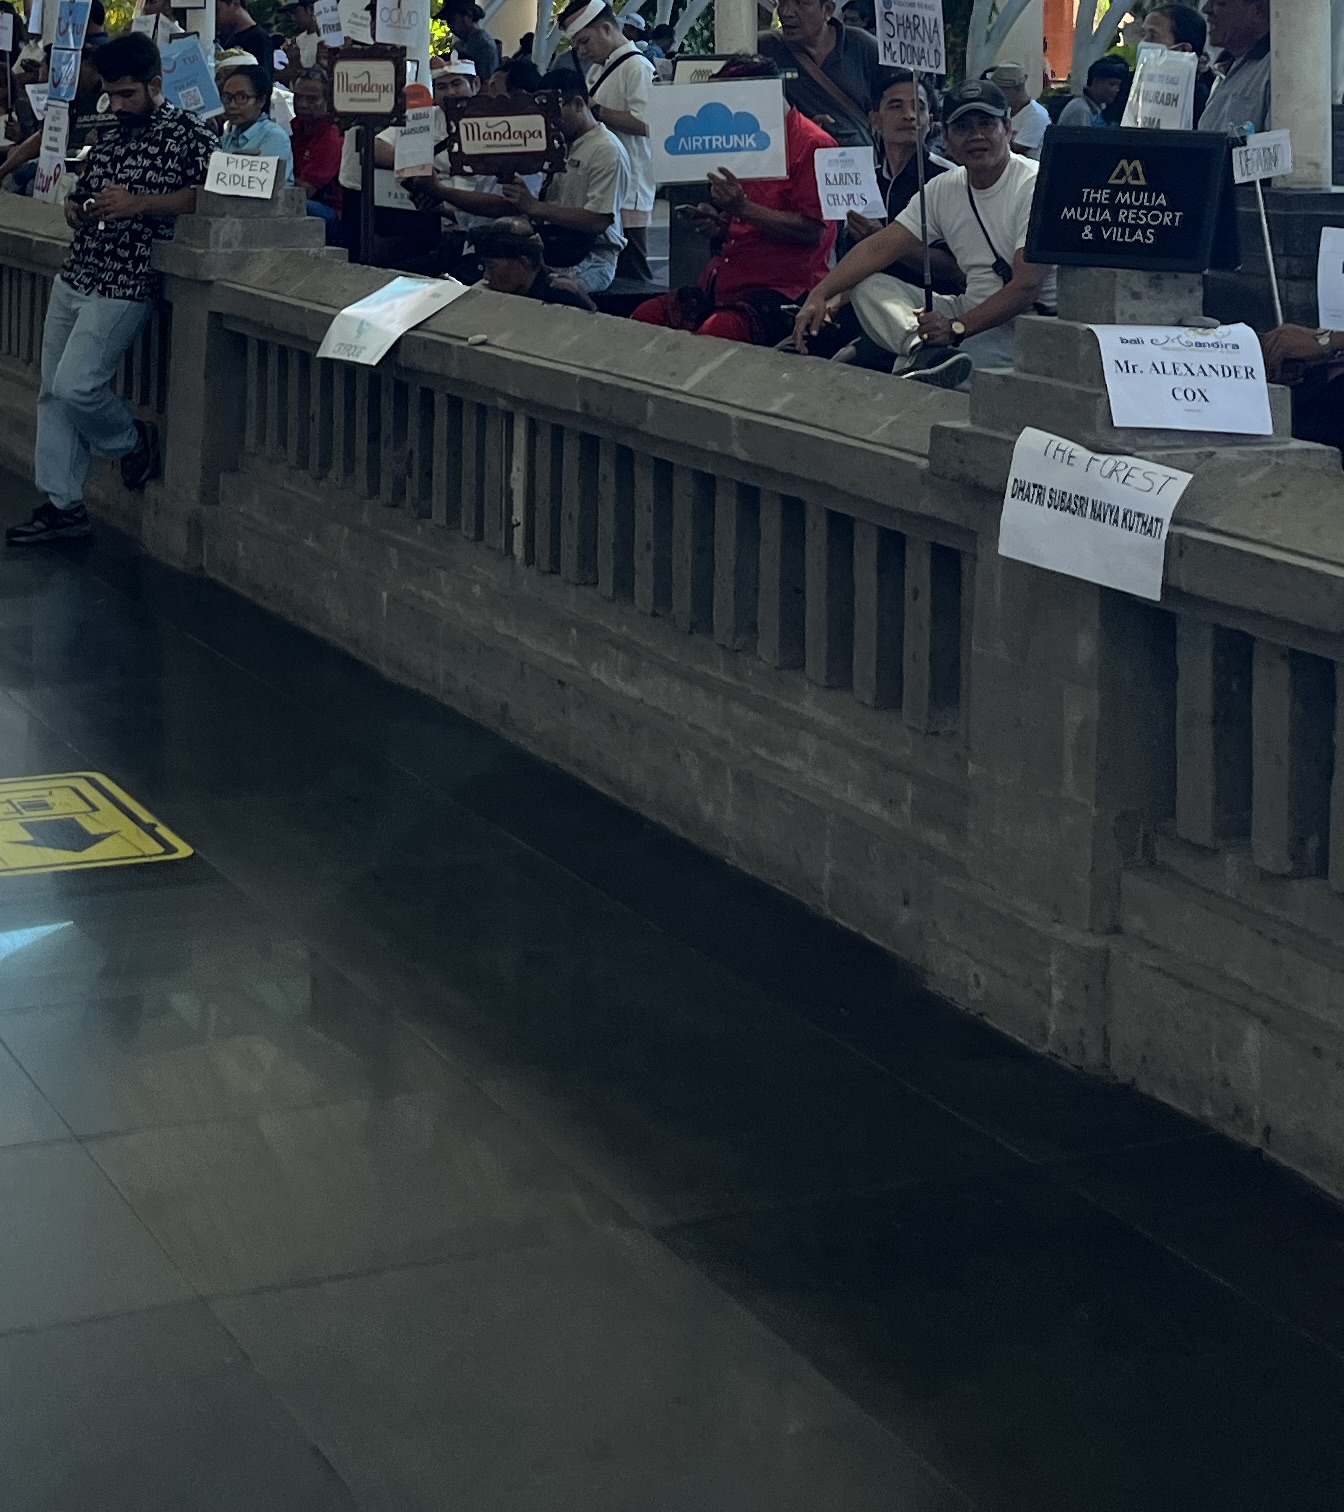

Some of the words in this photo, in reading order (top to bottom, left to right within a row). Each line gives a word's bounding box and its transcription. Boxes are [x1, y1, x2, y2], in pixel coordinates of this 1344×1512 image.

[884, 11, 942, 46] SHARNA
[337, 70, 394, 103] Mandapa
[462, 120, 543, 147] Mandapa
[677, 133, 757, 151] AIRTRUNK
[226, 156, 270, 174] PIPER
[216, 170, 268, 192] RIDLEY
[824, 172, 862, 186] KARINE
[826, 193, 868, 206] CHAPUS
[1081, 189, 1111, 204] THE
[1115, 191, 1167, 207] MULIA
[1061, 207, 1112, 222] MULIA
[1118, 209, 1184, 227] RESORT
[1081, 224, 1093, 240] &
[1101, 226, 1155, 244] VILLAS
[1120, 336, 1145, 345] bali
[1114, 359, 1144, 374] Mr.
[1149, 361, 1256, 380] ALEXANDER
[1171, 386, 1210, 403] COX
[1044, 439, 1081, 467] THE
[1085, 455, 1178, 496] FOREST
[1011, 477, 1046, 506] DHATRI
[1047, 486, 1089, 519] SUBASRI
[1089, 498, 1120, 528] NAVYA
[1121, 507, 1164, 539] KUTHATI
